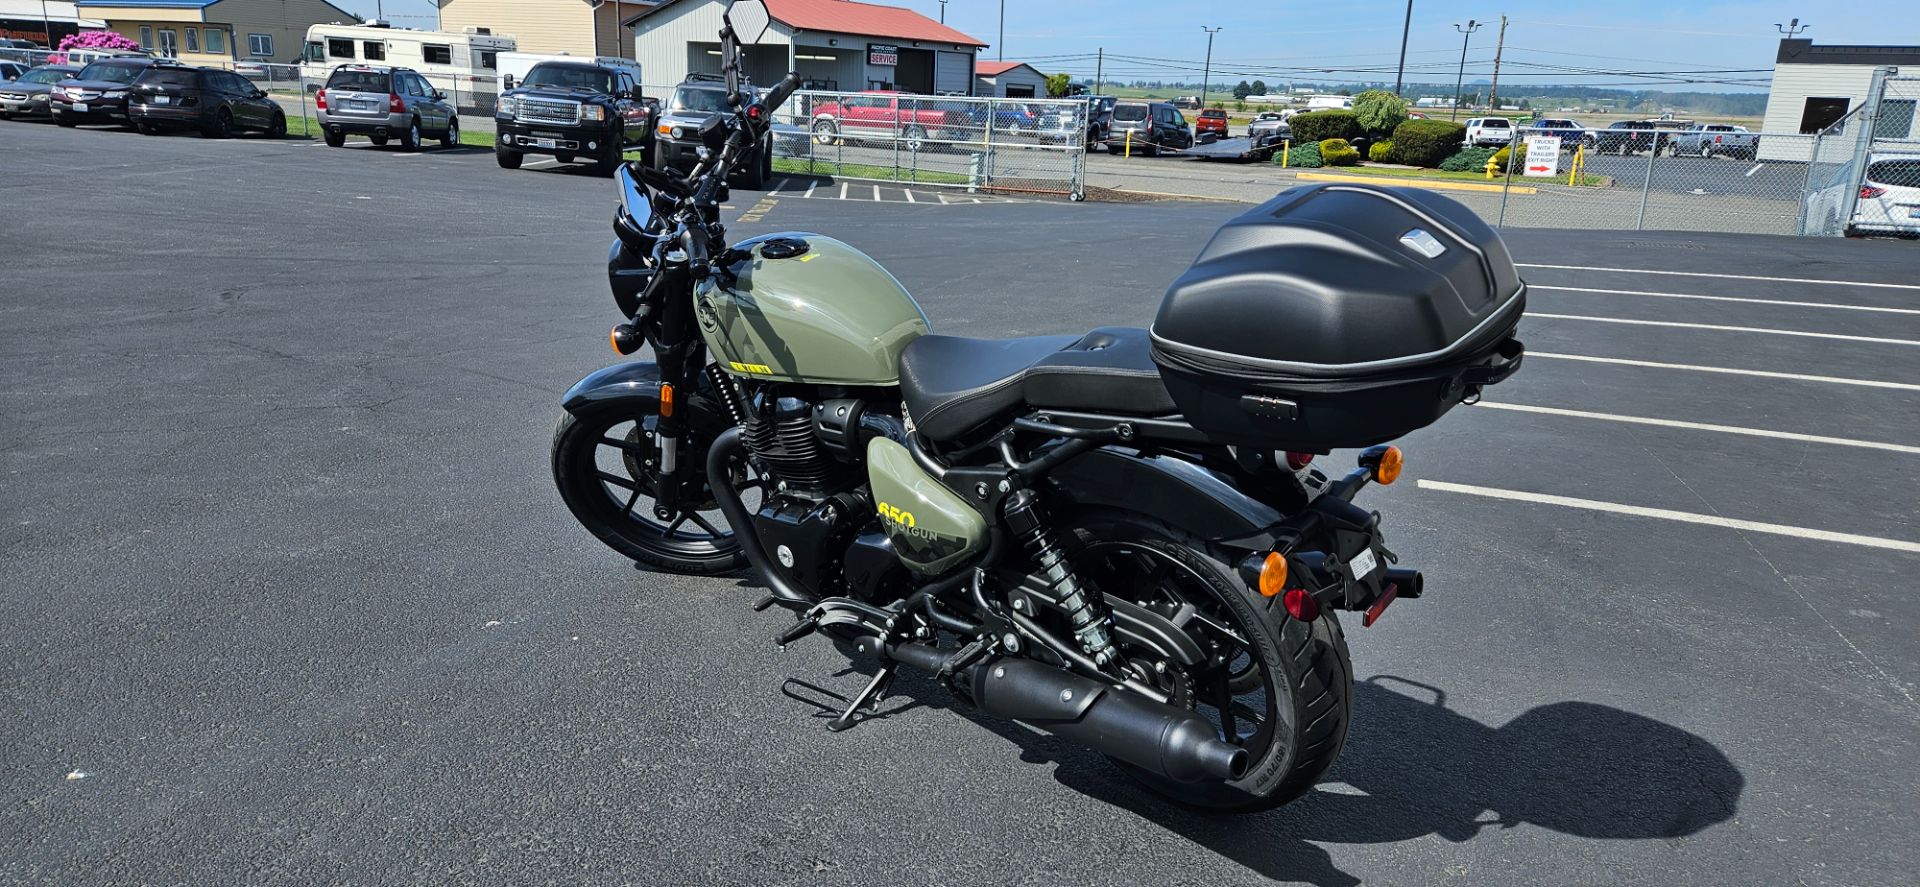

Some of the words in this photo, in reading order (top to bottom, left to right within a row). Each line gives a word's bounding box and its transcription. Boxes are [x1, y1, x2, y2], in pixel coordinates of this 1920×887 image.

[872, 54, 896, 64] SERVICE
[878, 501, 915, 528] 650
[885, 517, 938, 542] SHOTGUN
